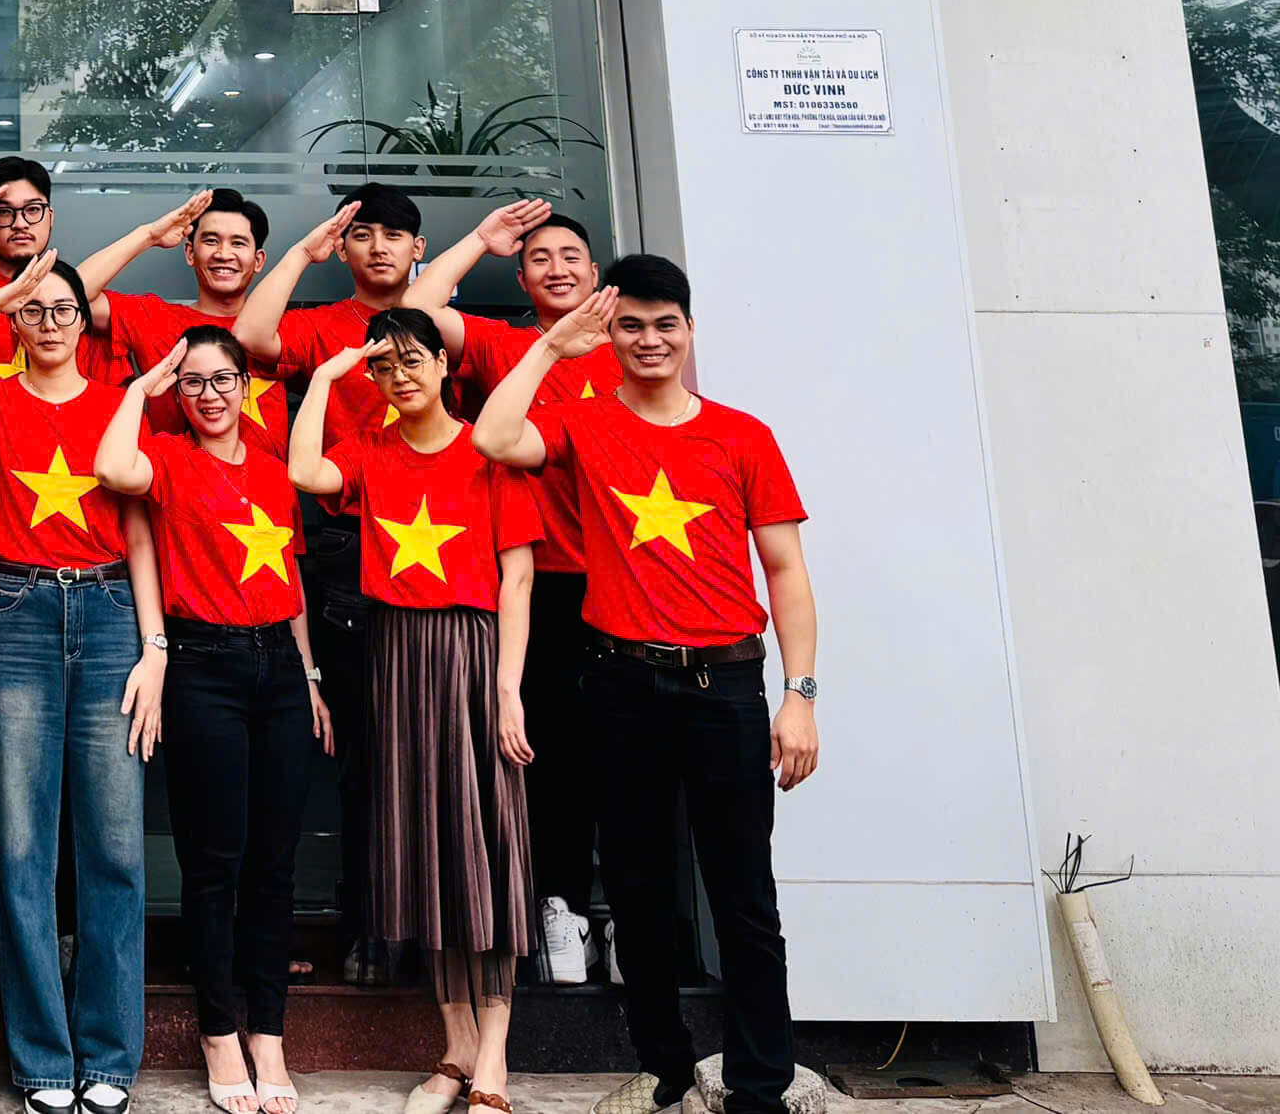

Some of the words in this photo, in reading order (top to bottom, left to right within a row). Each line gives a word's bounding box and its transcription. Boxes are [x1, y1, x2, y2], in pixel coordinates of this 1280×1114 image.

[770, 69, 779, 79] TY
[781, 69, 802, 79] TNHH
[848, 69, 859, 79] DU
[783, 82, 810, 95] ĐỨC
[813, 84, 846, 96] VINH
[773, 100, 798, 109] MST:
